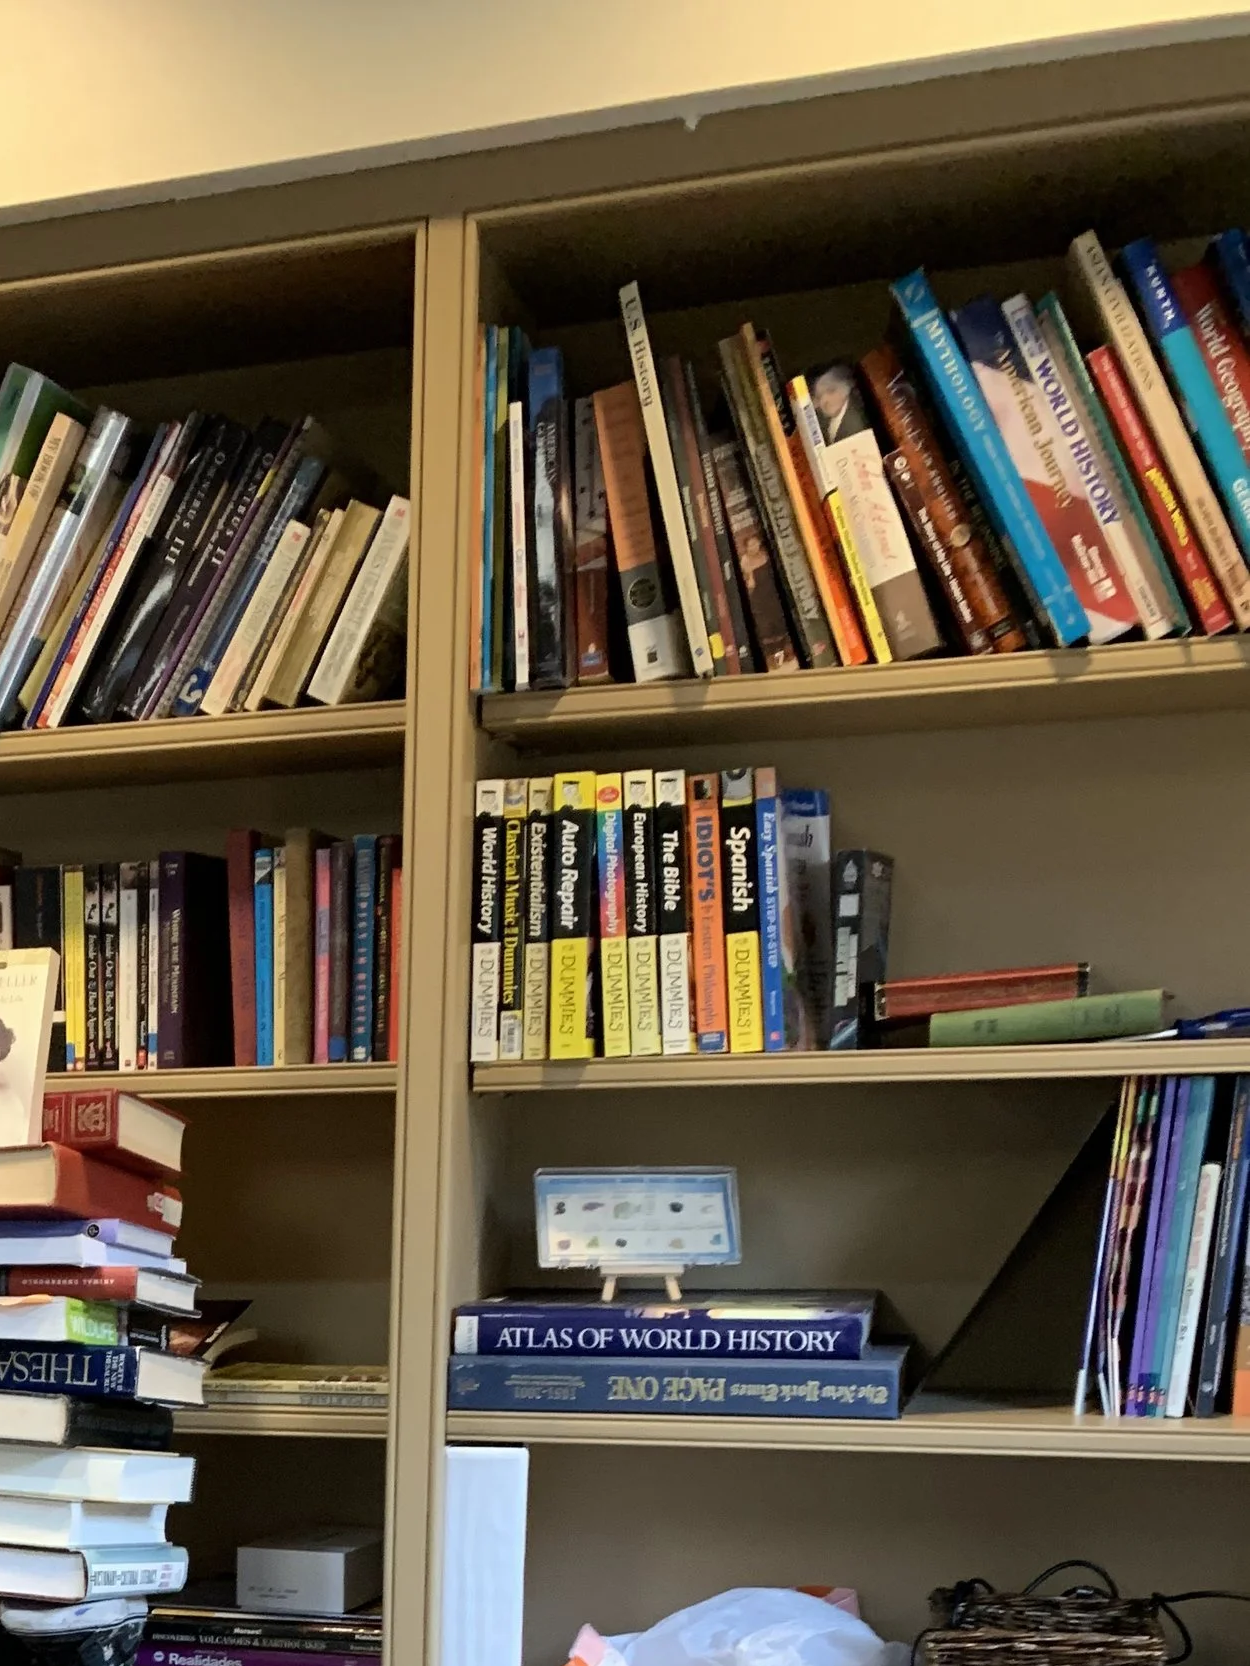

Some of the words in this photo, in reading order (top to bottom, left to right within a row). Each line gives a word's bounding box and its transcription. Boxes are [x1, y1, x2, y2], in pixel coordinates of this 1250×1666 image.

[623, 297, 642, 337] U.S.
[1142, 263, 1176, 322] KUNTH
[1102, 284, 1157, 392] CIVILIZATIONS
[1195, 302, 1231, 359] World
[629, 339, 656, 408] History
[923, 316, 988, 436] MYTHOLOGY
[993, 346, 1044, 438] American
[1032, 435, 1078, 510] Journey
[1032, 356, 1081, 439] WORLD
[1068, 436, 1122, 528] HISTORY
[180, 449, 227, 532] OMNIBUS
[224, 449, 274, 540] OMNIBUS
[1143, 465, 1176, 513] MODERN
[1166, 507, 1192, 547] WORLD
[163, 535, 185, 564] III
[209, 545, 226, 566] II
[481, 827, 497, 873] World
[505, 820, 521, 880] Classical
[560, 820, 579, 866] Auto
[603, 812, 618, 851] Digital
[631, 812, 647, 880] European
[662, 831, 678, 863] The
[762, 812, 775, 841] Easy
[529, 822, 546, 936] Existentialism
[695, 816, 715, 902] IDIOT'S
[726, 826, 753, 911] Spanish
[763, 844, 778, 893] Spanish
[477, 876, 496, 934] History
[504, 883, 519, 926] Music
[557, 868, 578, 929] Repair
[605, 854, 622, 934] Photography
[634, 883, 651, 933] History
[663, 866, 679, 911] Bible
[88, 933, 97, 959] Inside
[105, 933, 114, 958] Inside
[171, 908, 181, 944] WHERE
[701, 916, 715, 960] Eastern
[766, 896, 777, 968] STEP-BY-STEP
[88, 961, 97, 979] Out
[105, 960, 114, 978] Out
[171, 945, 180, 964] THE
[503, 937, 518, 1004] Dummies
[88, 991, 97, 1014] Back
[105, 990, 114, 1012] Back
[171, 964, 181, 1014] MOUNTAIN
[479, 959, 495, 1038] DUMMIES
[527, 958, 542, 1037] DUMMIES
[559, 955, 577, 1034] DUMMIES
[607, 953, 625, 1032] DUMMIES
[636, 951, 653, 1031] DUMMIES
[667, 949, 683, 1029] DUMMIES
[702, 964, 720, 1027] Philosophy
[734, 950, 751, 1028] DUMMIES
[87, 1015, 97, 1040] Again
[104, 1014, 115, 1039] Again
[70, 1314, 117, 1342] WILDLIFE
[505, 1326, 583, 1349] ATLAS
[588, 1327, 624, 1350] OF
[628, 1327, 731, 1351] WORLD
[737, 1329, 852, 1353] HISTORY
[608, 1375, 659, 1401] ONE
[663, 1375, 726, 1403] PAGE
[731, 1382, 778, 1402] Times
[779, 1379, 820, 1404] York
[820, 1381, 856, 1404] New
[857, 1383, 889, 1406] The
[198, 1635, 251, 1647] VOLCANOES
[252, 1638, 260, 1648] &
[262, 1638, 327, 1650] EARTHQUAKES
